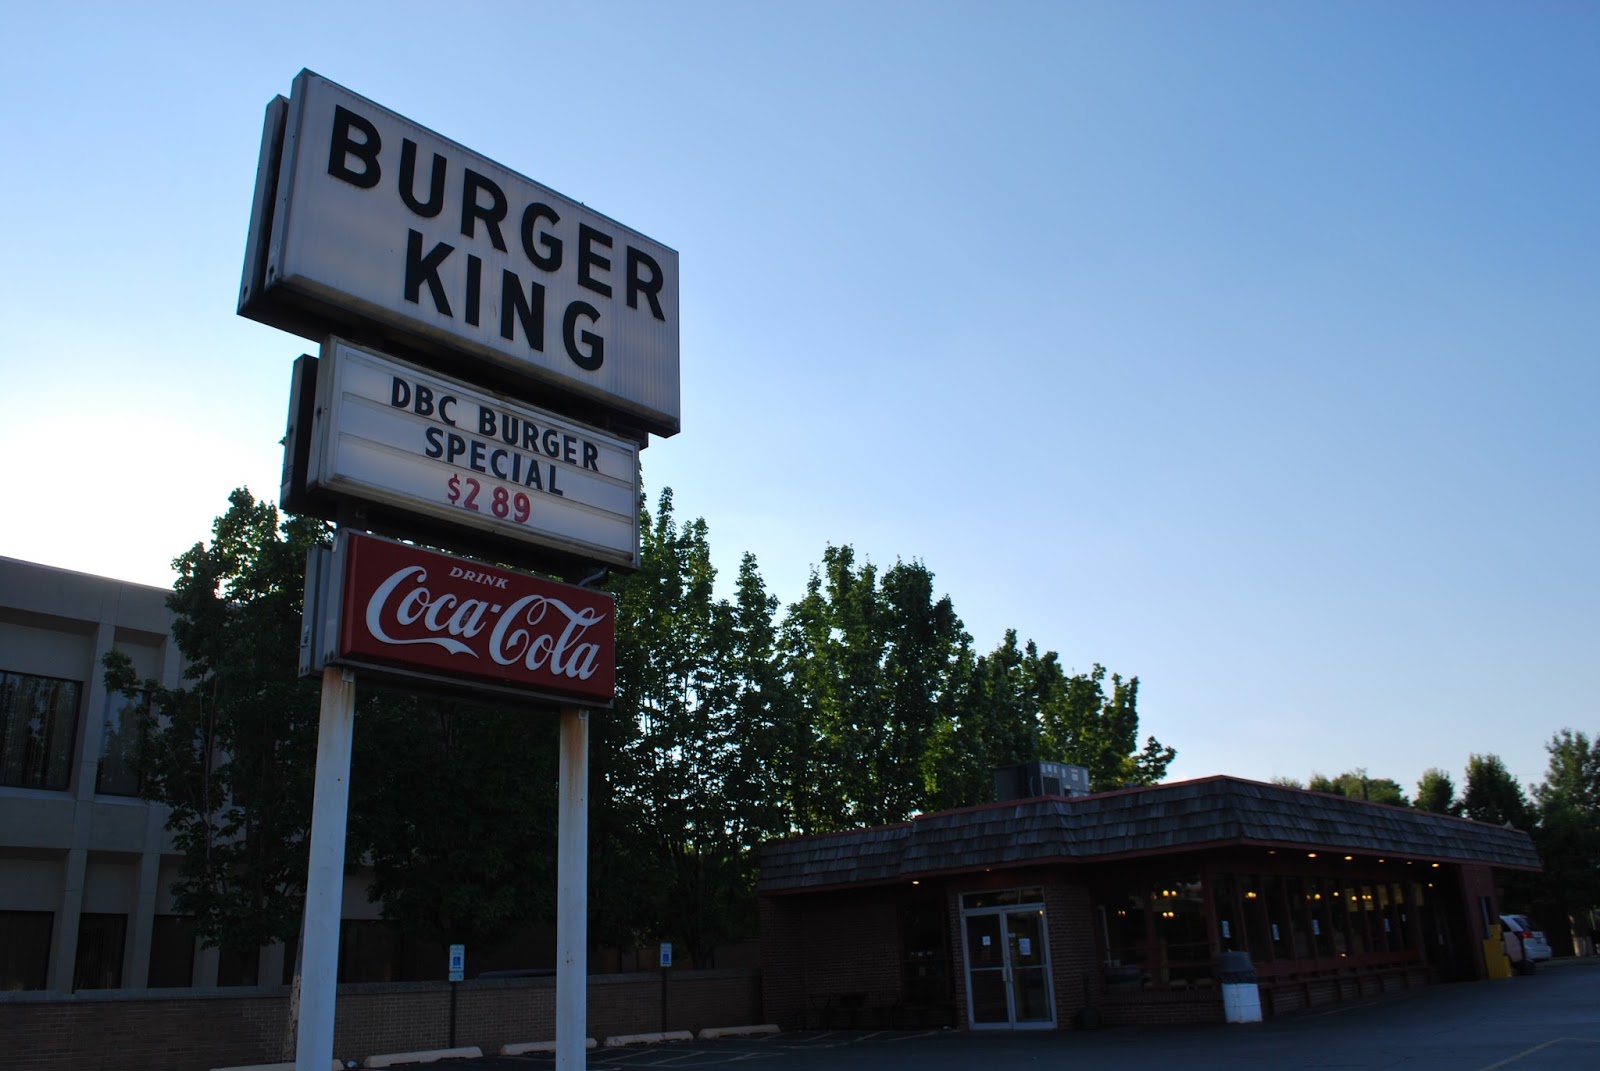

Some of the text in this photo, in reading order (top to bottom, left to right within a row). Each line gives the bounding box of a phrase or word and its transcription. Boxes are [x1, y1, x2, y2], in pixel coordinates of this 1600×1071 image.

[327, 104, 666, 322] BURGER
[404, 228, 604, 371] KING
[391, 376, 600, 472] DBC BURGER
[425, 427, 564, 496] SPECIAL
[448, 566, 509, 589] DRINK
